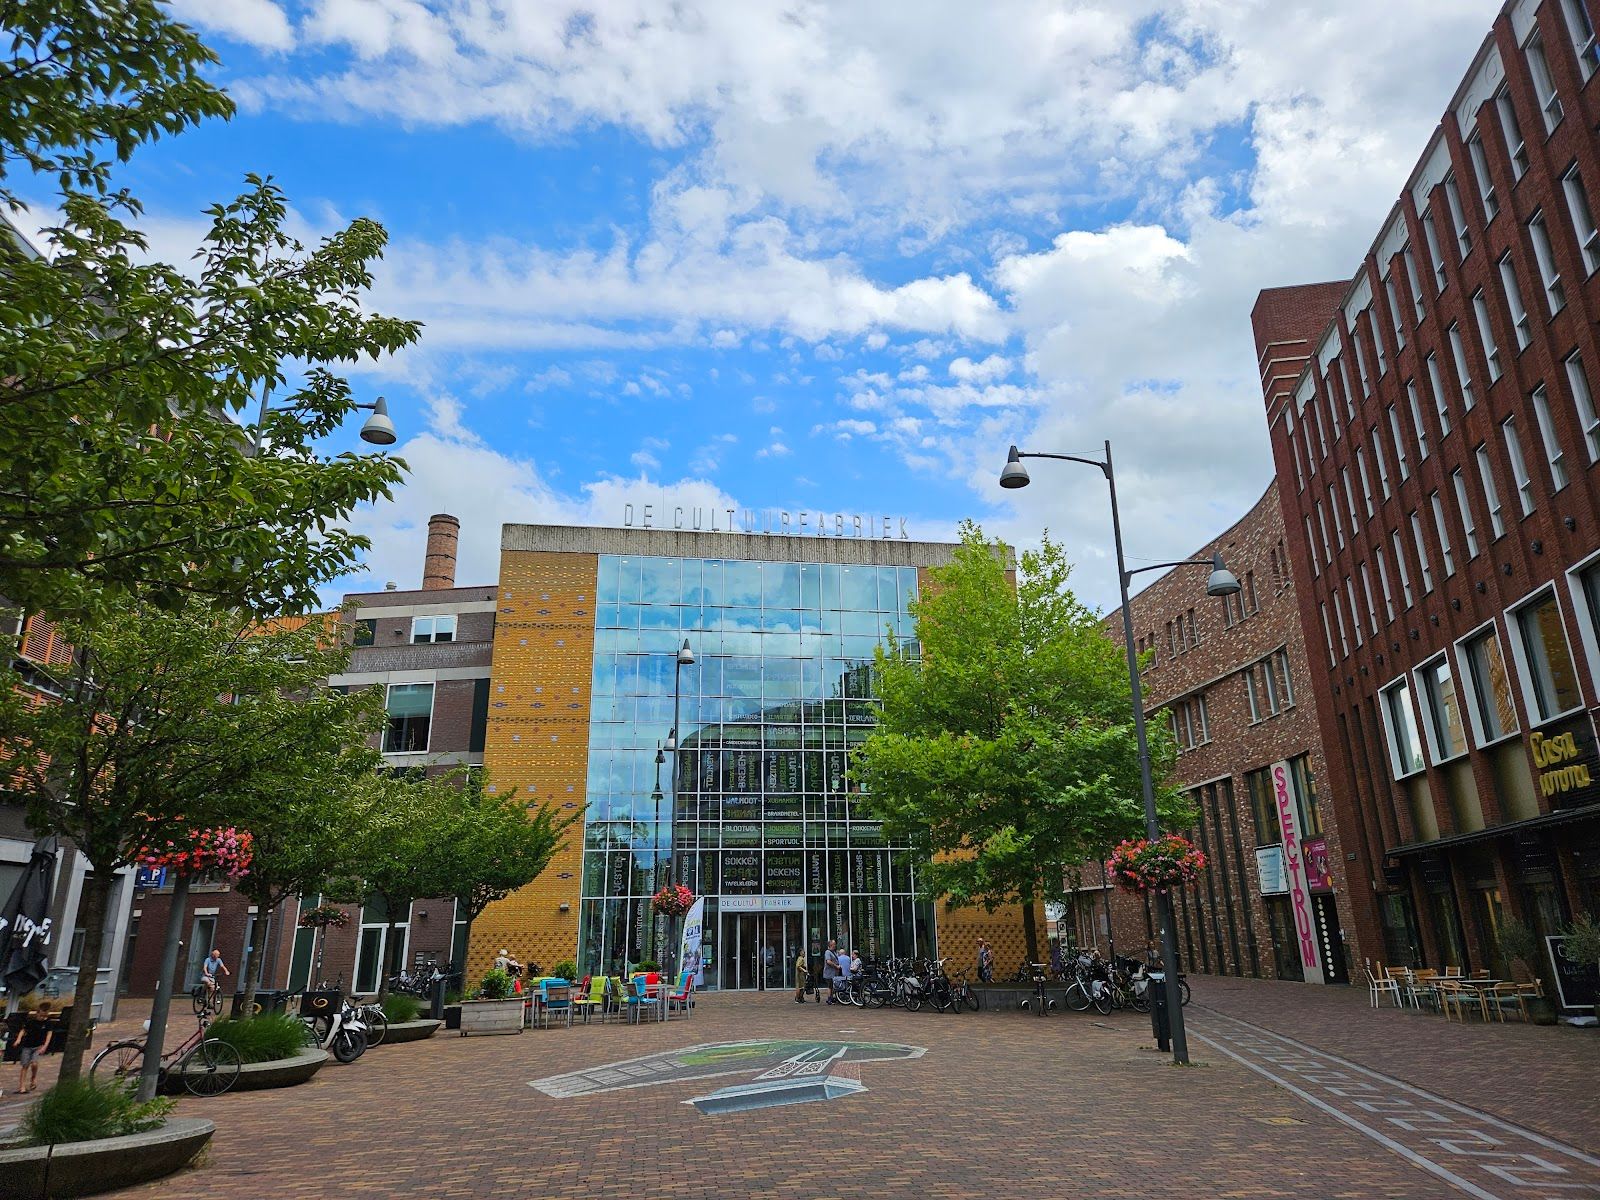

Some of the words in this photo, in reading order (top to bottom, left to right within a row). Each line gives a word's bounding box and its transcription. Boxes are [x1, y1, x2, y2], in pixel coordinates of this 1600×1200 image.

[624, 504, 653, 528] DE
[674, 507, 909, 540] CULTUURFABRIEK
[1530, 732, 1578, 768] Casa
[725, 857, 758, 865] SOKKEN
[768, 868, 800, 876] DEKENS
[1274, 766, 1316, 968] SPECTRUM
[151, 869, 160, 880] P
